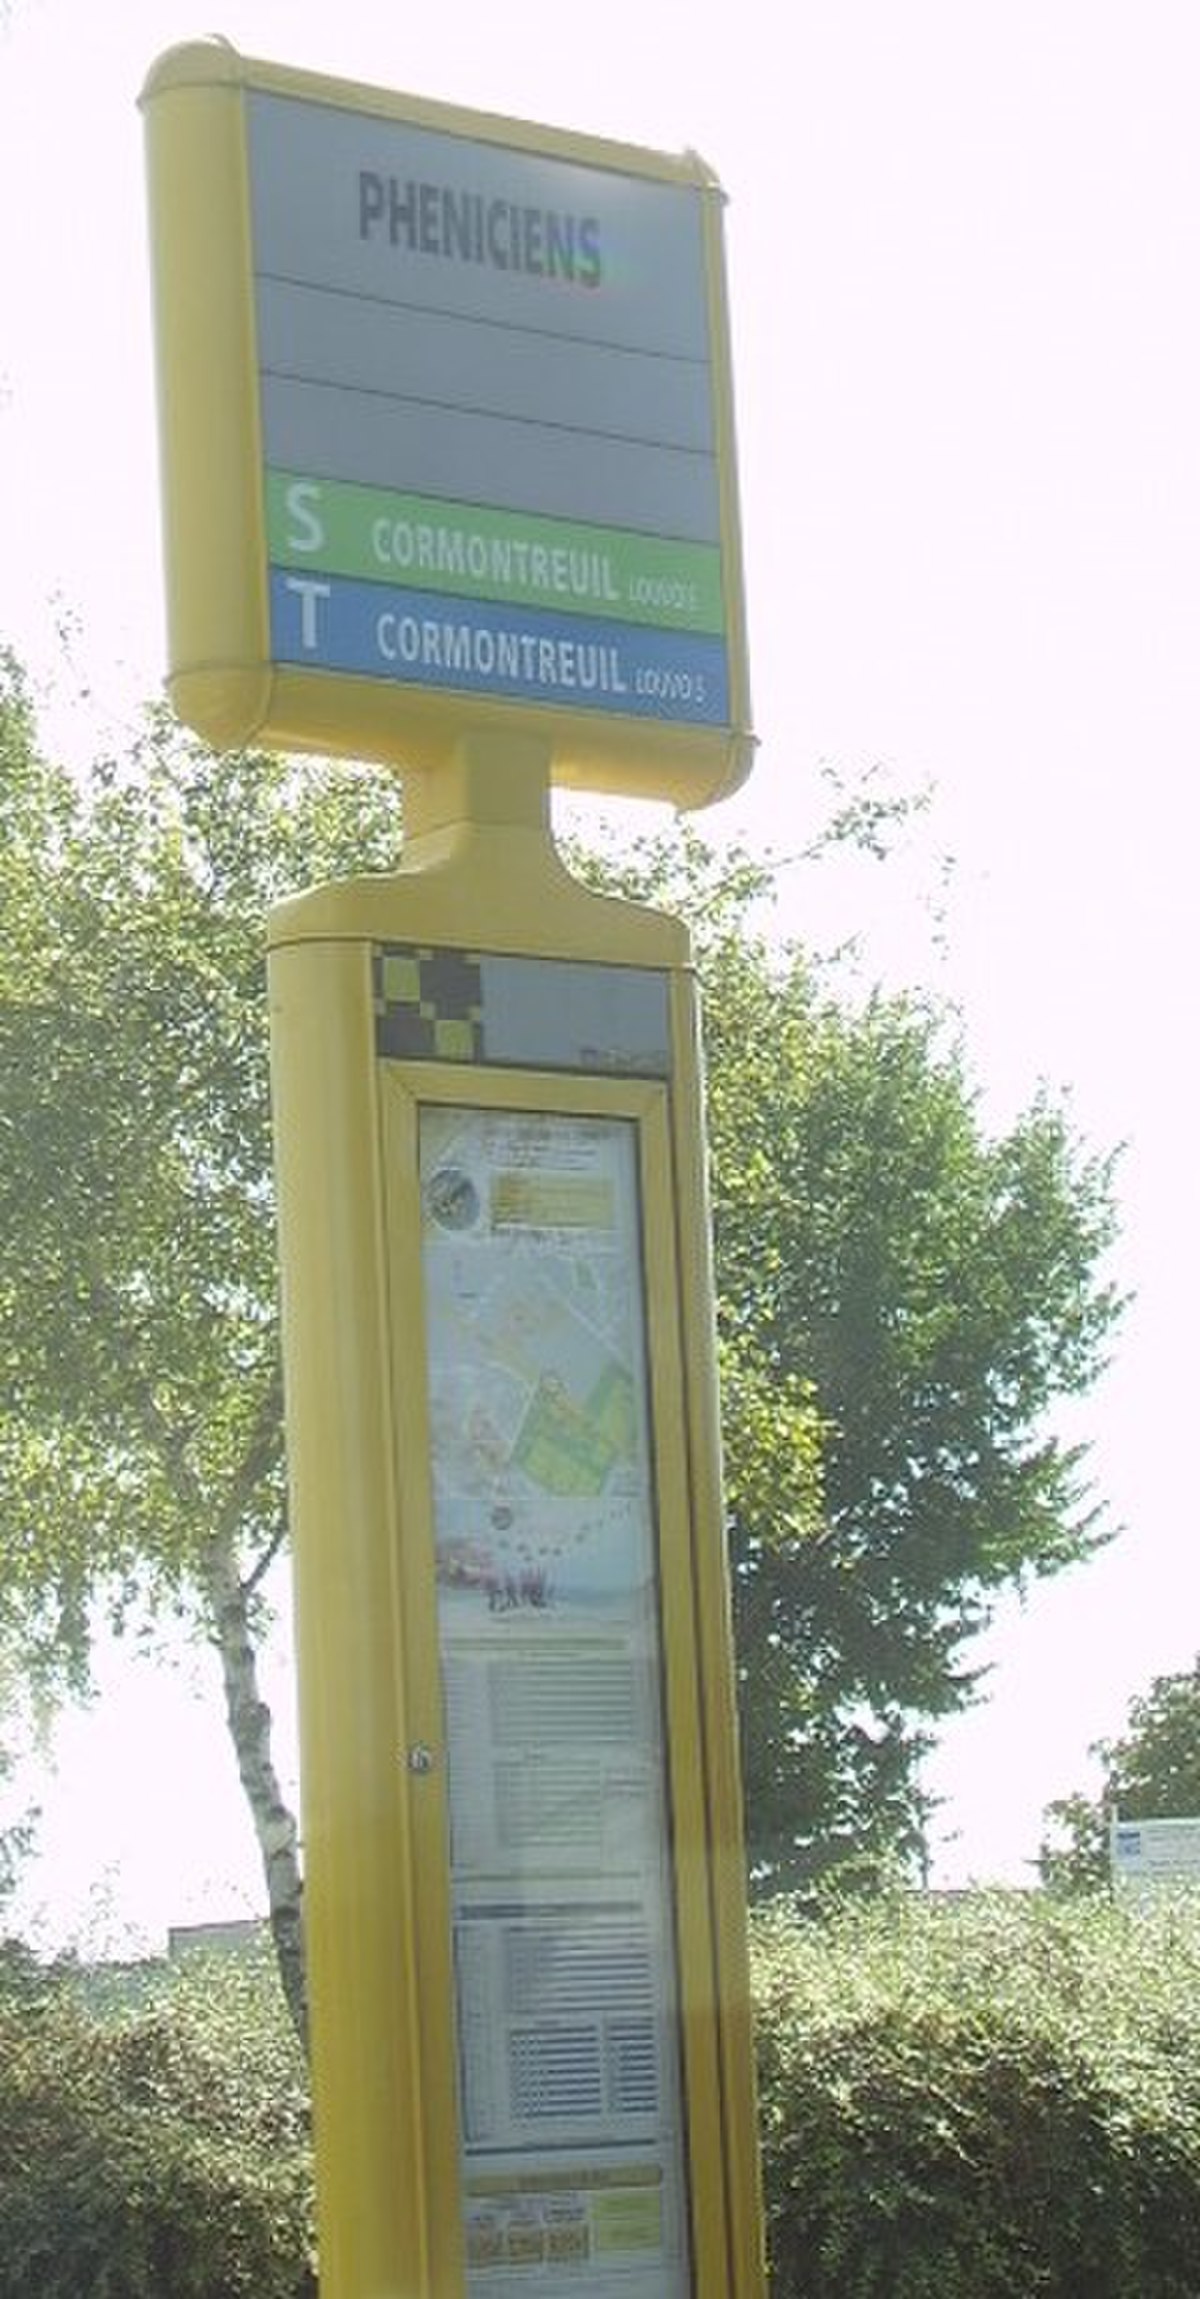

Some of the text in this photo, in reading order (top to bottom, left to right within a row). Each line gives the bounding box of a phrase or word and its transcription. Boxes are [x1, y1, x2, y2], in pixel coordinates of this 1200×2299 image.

[358, 171, 602, 289] PHENICIENS
[286, 484, 325, 553] S
[373, 518, 619, 601] CORMONTREUIL
[286, 579, 331, 650] T
[376, 613, 627, 693] CORMONTREUIL
